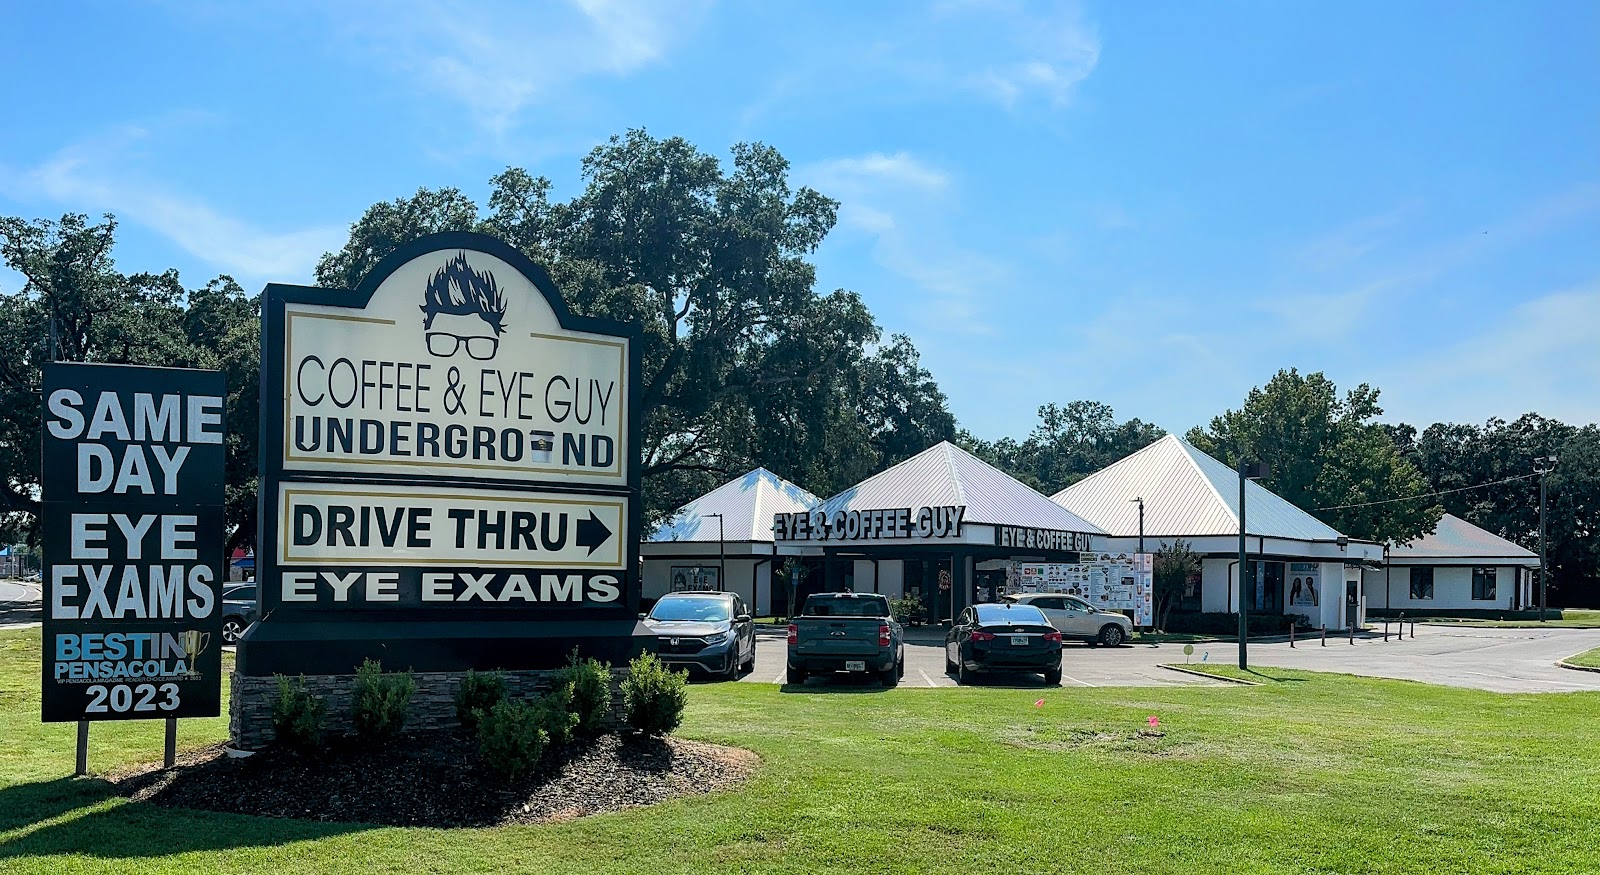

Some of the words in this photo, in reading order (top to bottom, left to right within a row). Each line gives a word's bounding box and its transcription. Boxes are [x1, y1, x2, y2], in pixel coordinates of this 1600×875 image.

[297, 355, 432, 413] COFFEE
[443, 365, 467, 415] &
[479, 368, 534, 421] EYE
[545, 375, 615, 427] GUY
[46, 388, 223, 444] SAME
[295, 415, 614, 468] UNDERGROND
[77, 443, 192, 495] DAY
[71, 513, 198, 560] EYE
[293, 504, 433, 549] DRIVE
[448, 508, 568, 552] THRU
[773, 512, 811, 540] EYE
[812, 511, 829, 541] &
[832, 509, 912, 541] COFFEE
[916, 505, 966, 538] GUY
[1001, 526, 1024, 548] EYE
[1026, 528, 1036, 549] &
[1036, 529, 1074, 551] COFFEE
[1074, 533, 1094, 552] GUY
[51, 564, 215, 620] EXAMS
[282, 571, 399, 602] EYE
[421, 572, 620, 603] EXAMS
[693, 575, 708, 584] EE
[54, 659, 190, 680] PENSACOLA
[85, 683, 181, 713] 2023
